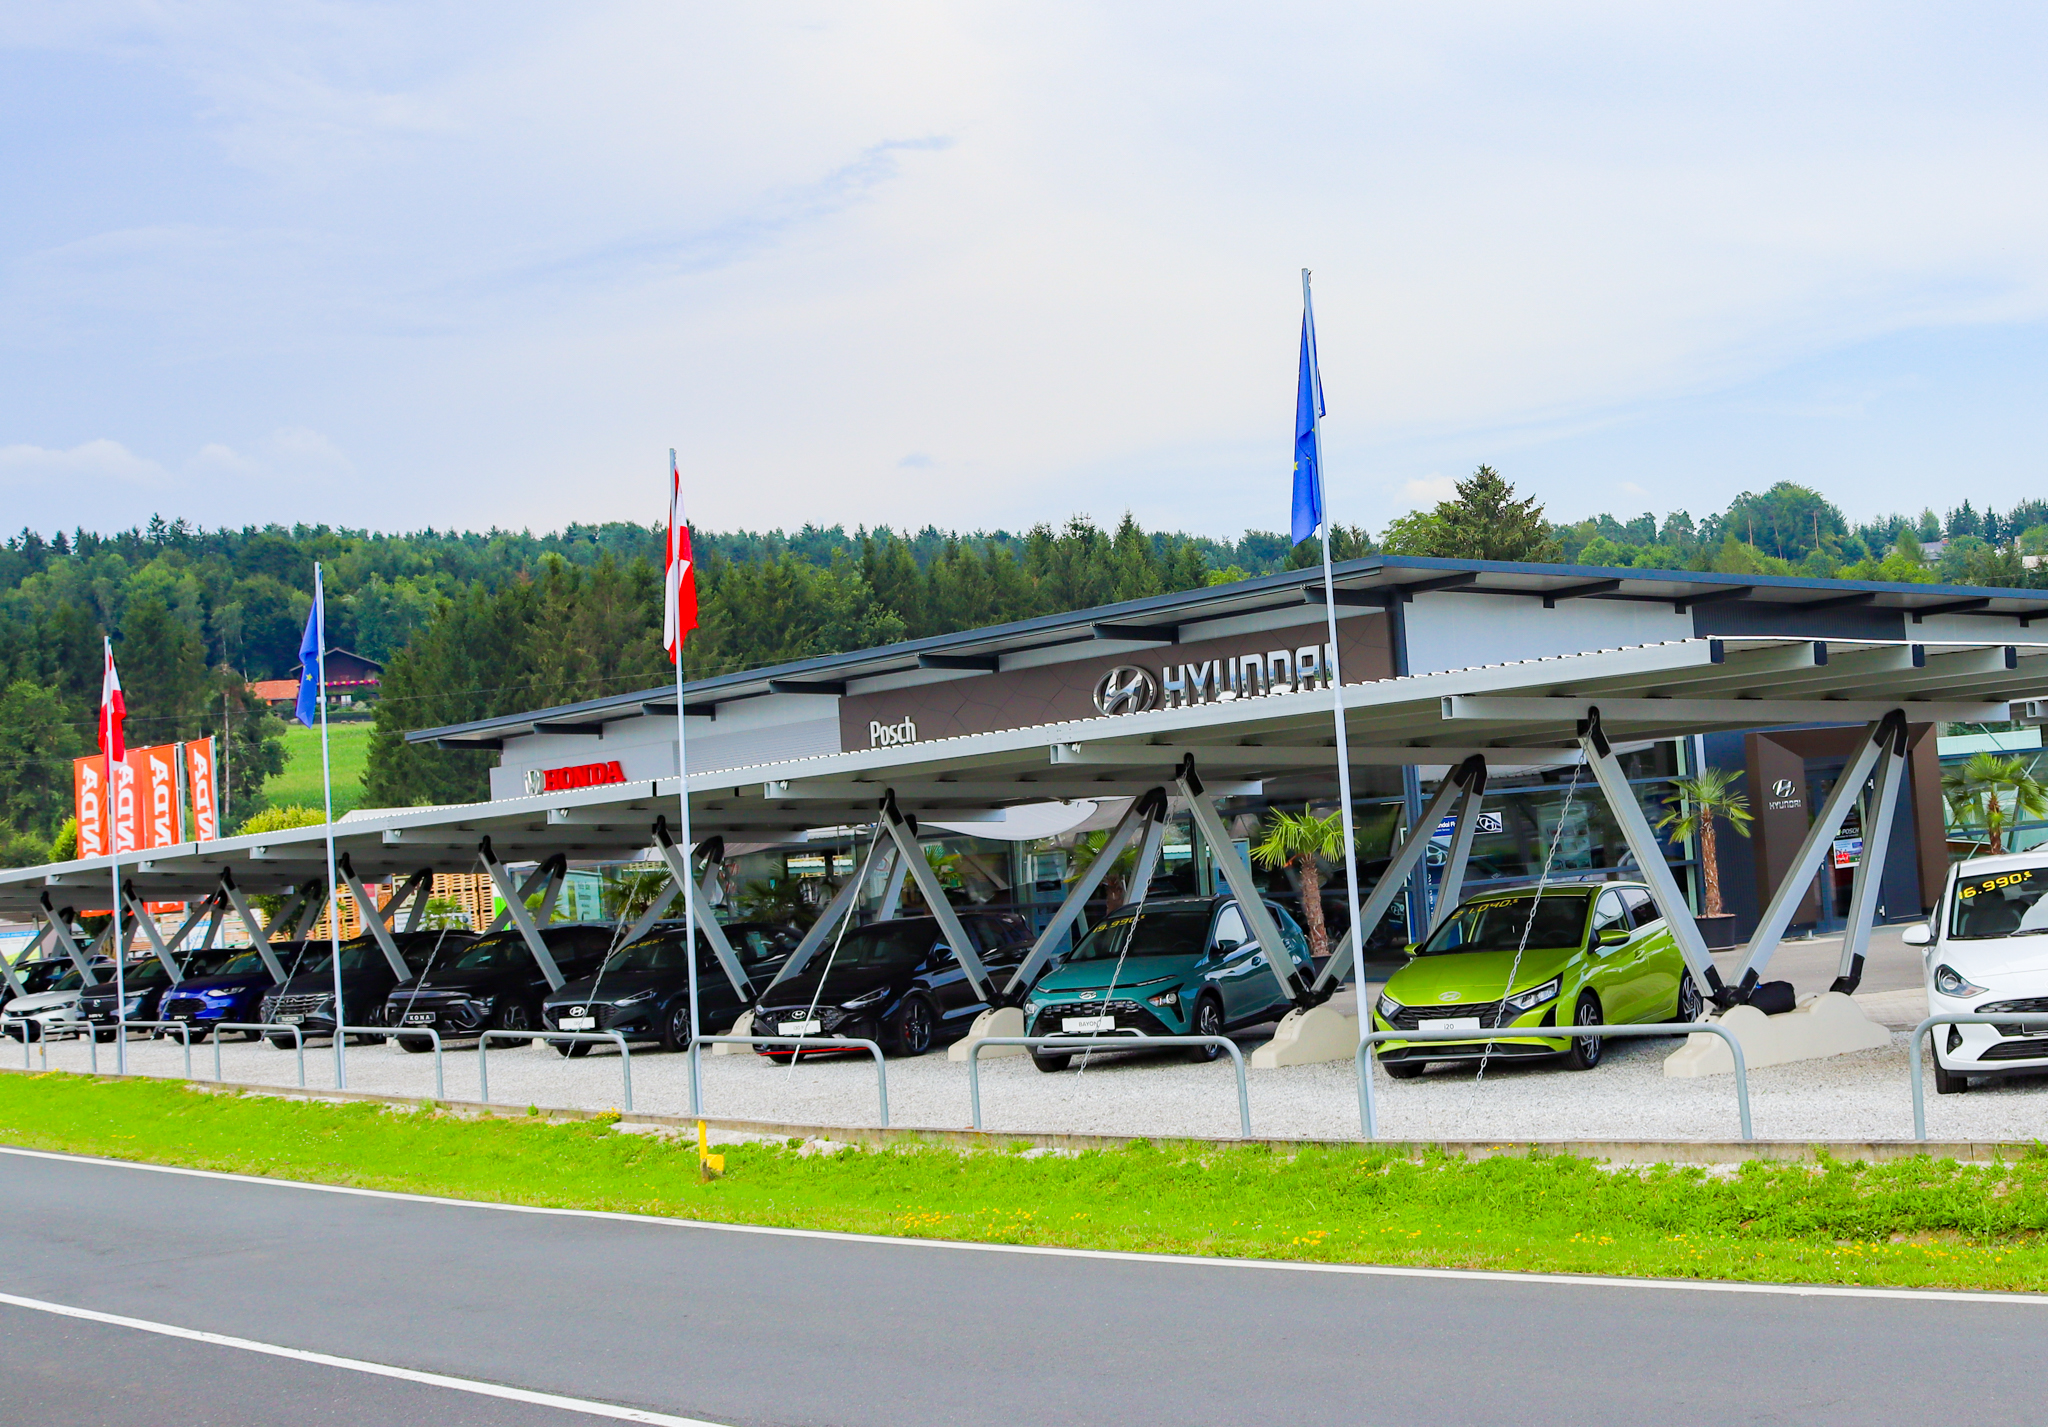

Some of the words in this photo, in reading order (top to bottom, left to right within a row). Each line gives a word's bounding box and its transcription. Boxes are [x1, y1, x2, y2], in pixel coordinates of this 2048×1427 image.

[1162, 643, 1334, 708] HYUNDAI
[869, 715, 917, 747] Posch
[543, 760, 627, 791] HONDA
[1769, 800, 1802, 810] HYUNDAI
